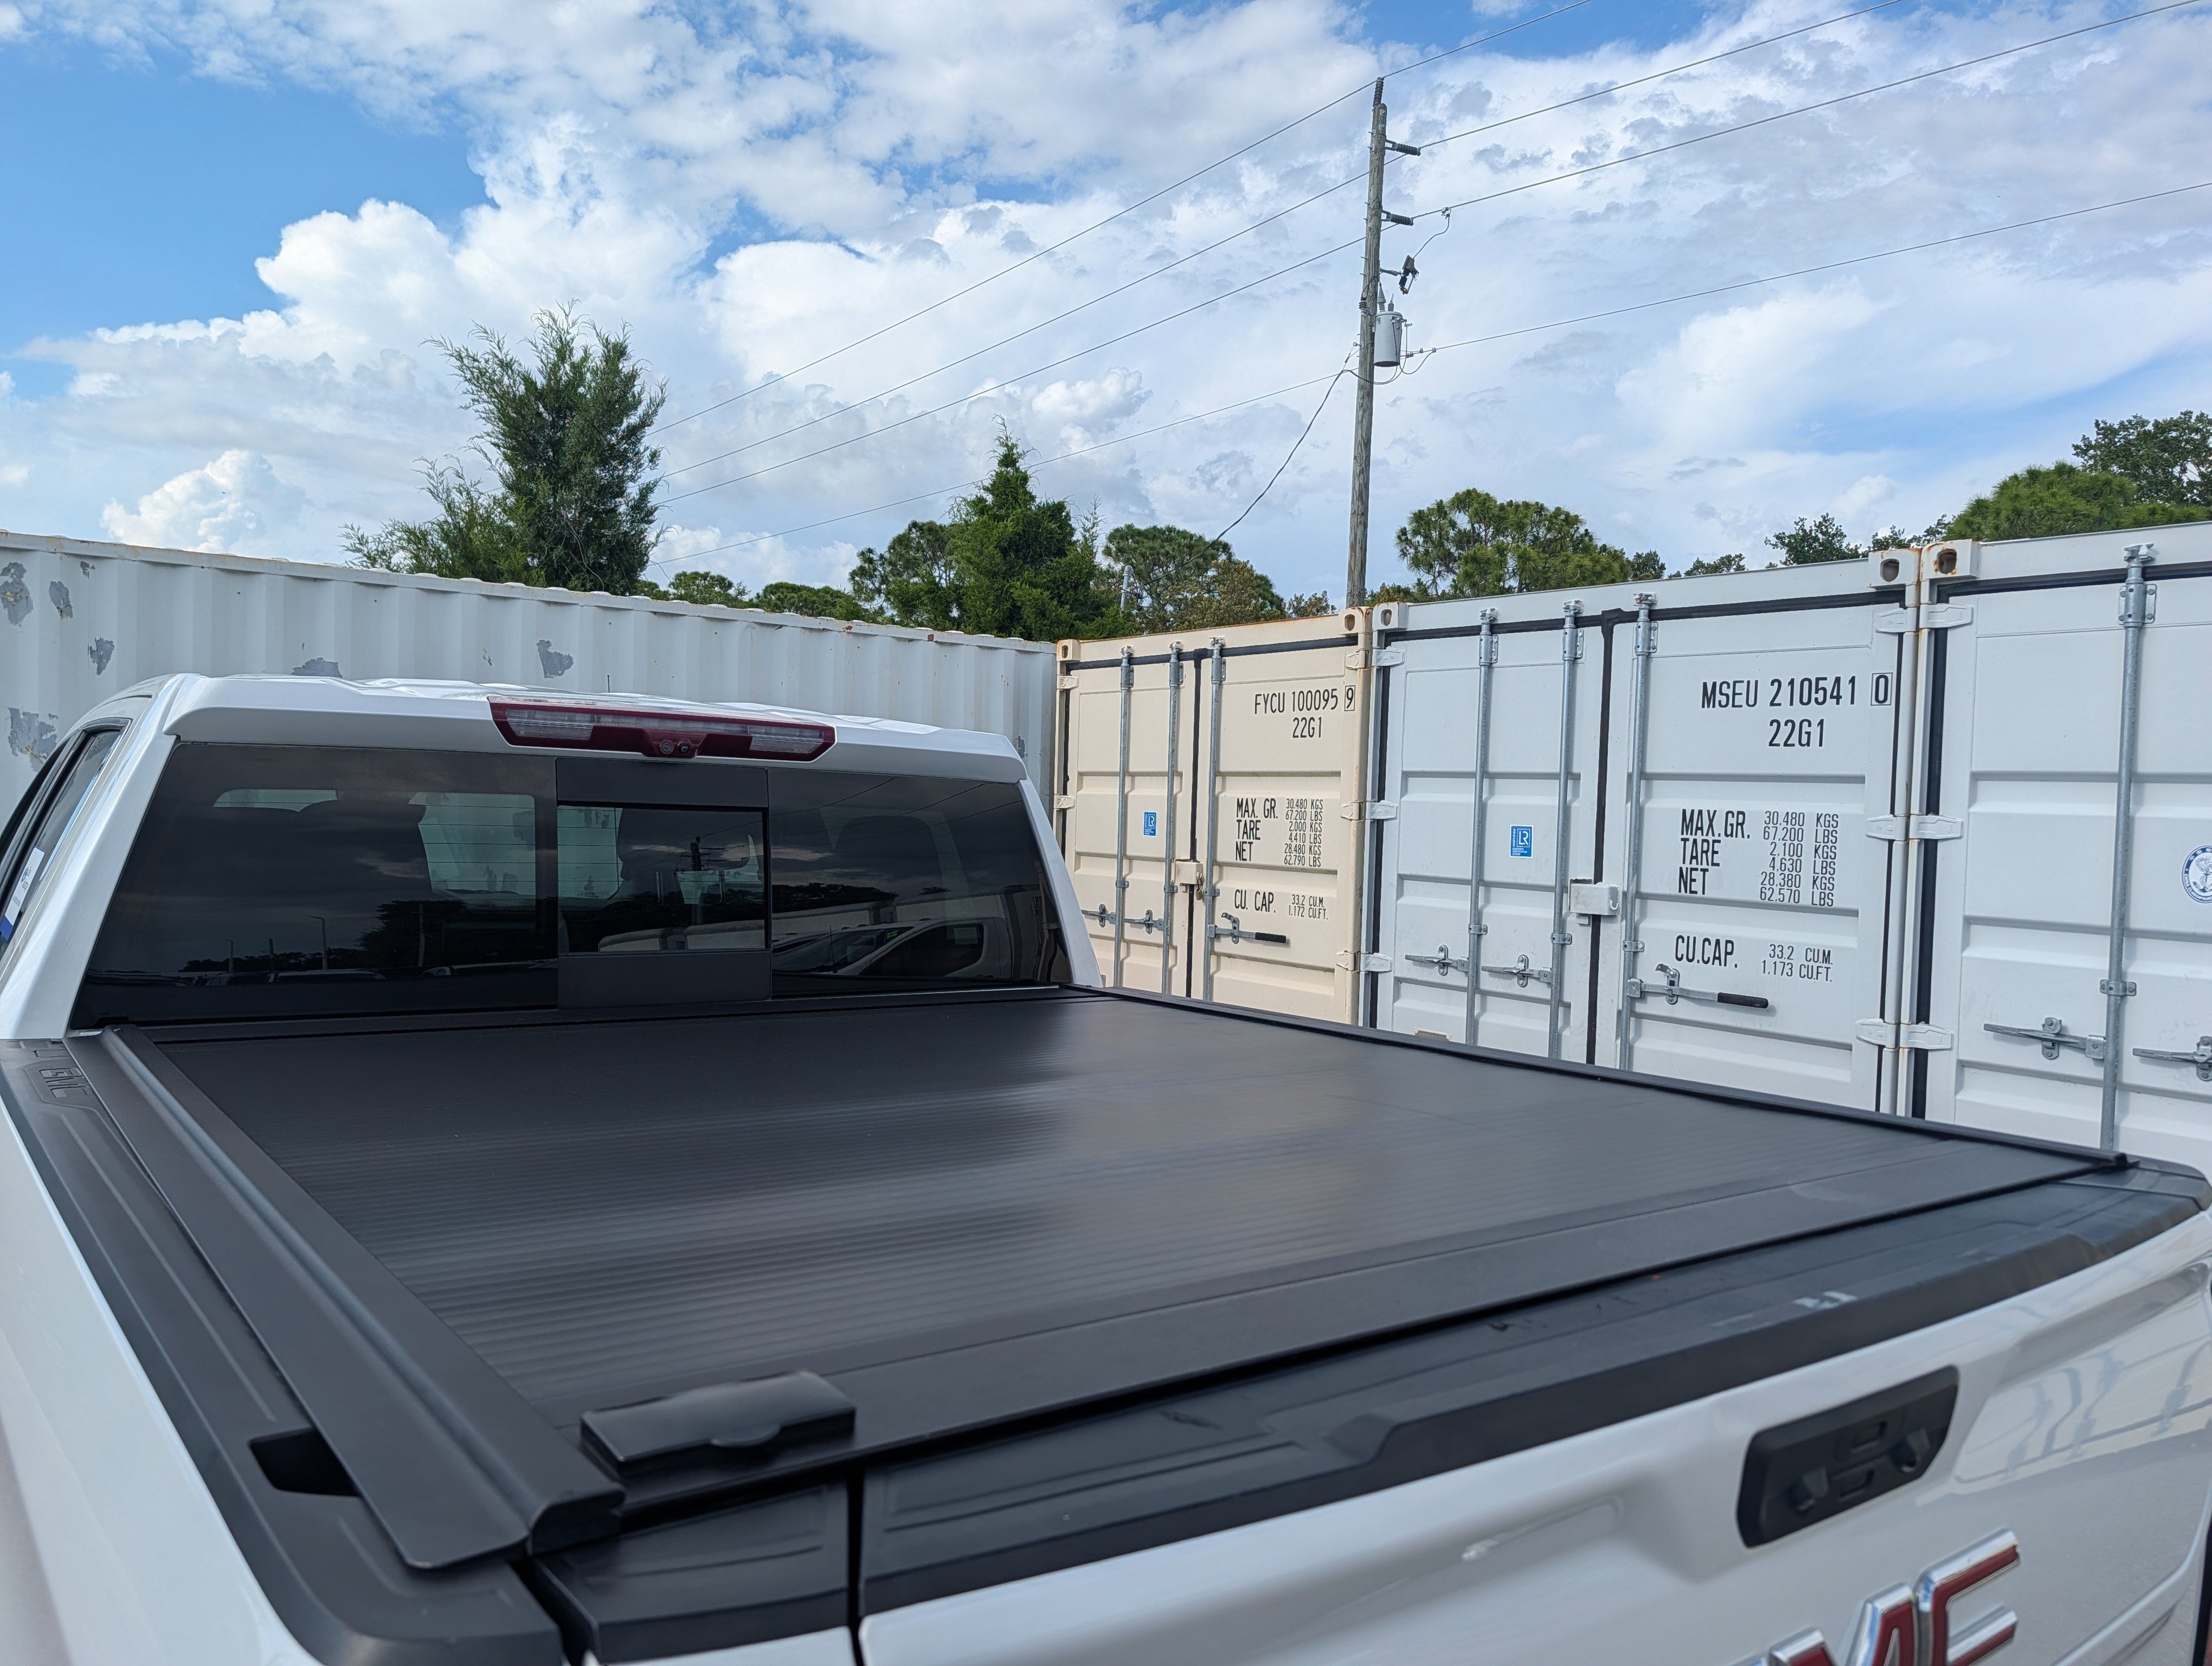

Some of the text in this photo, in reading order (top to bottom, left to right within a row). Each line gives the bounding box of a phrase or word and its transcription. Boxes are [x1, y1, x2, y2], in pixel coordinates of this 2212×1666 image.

[1255, 687, 1354, 714] FYCU 100095 9
[1701, 674, 1889, 708] MSEU 210541 0
[1293, 716, 1322, 738] 22G1
[1769, 719, 1824, 747] 22G1
[1237, 798, 1258, 818] MAX.
[1263, 798, 1278, 819] GR.
[1310, 799, 1323, 810] KGS
[1310, 811, 1323, 822] LBS
[1236, 819, 1261, 840] TARE
[1309, 822, 1322, 833] KGS
[1764, 811, 1805, 826] 30,480
[1816, 813, 1839, 828] KGS
[1309, 833, 1322, 844] LBS
[1763, 826, 1838, 844] 67,200 LBS
[1236, 841, 1253, 862] NET
[1309, 844, 1321, 856] KGS
[1309, 856, 1321, 867] LBS
[1680, 838, 1837, 867] TARE 2,100 KGS
[1769, 857, 1836, 875] 4,630 LBS
[1679, 867, 1835, 895] NET 28,380 KGS
[1234, 889, 1325, 913] CU. CAP. 33.2 CU.M.
[1760, 887, 1834, 907] 62,570 LBS
[1308, 907, 1328, 920] CU.FT.
[1769, 944, 1795, 960] 33.2
[1805, 947, 1833, 965] CU.M.
[1799, 964, 1832, 982] CU.FT.
